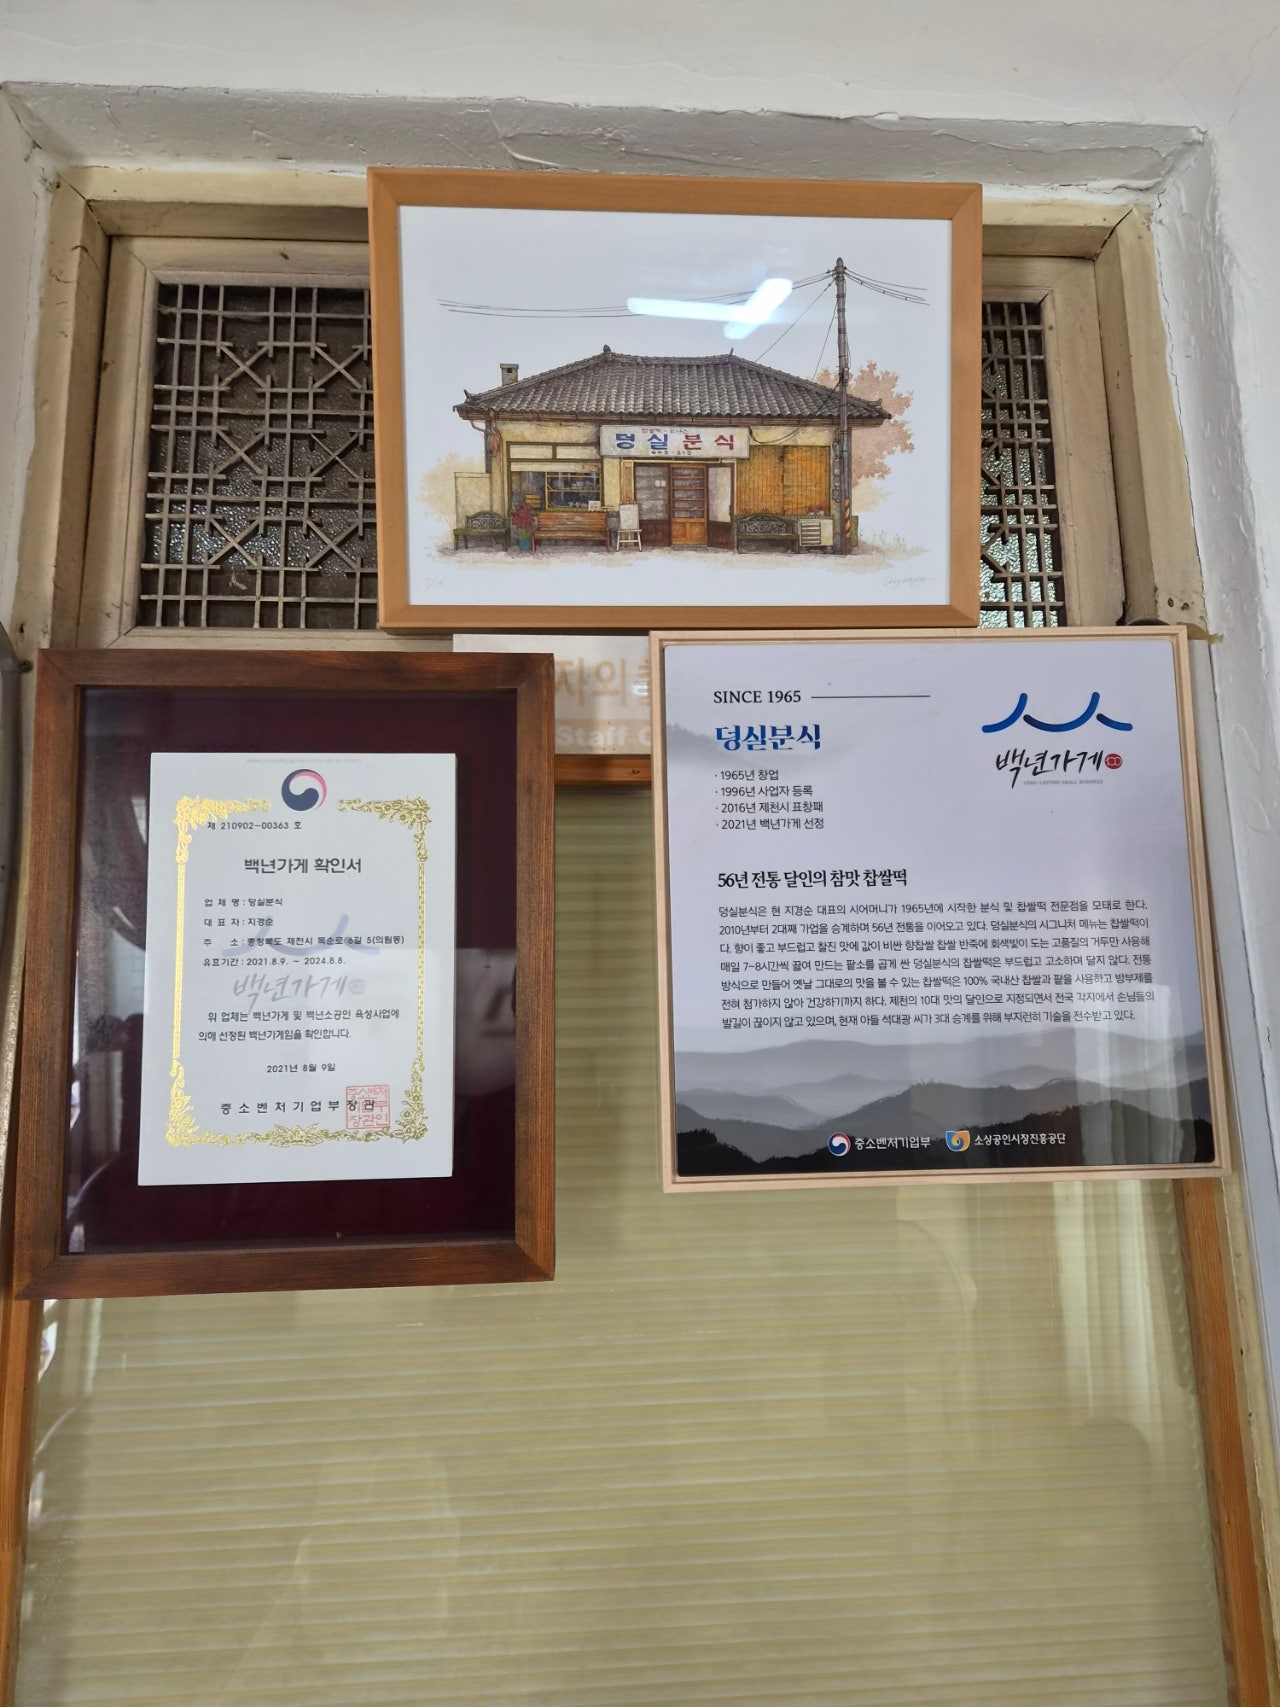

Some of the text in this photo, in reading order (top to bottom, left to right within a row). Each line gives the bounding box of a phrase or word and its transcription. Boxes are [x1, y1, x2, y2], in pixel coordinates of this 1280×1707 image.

[616, 433, 734, 450] 덩실분식
[713, 690, 801, 703] SINCE 1965
[555, 725, 628, 747] Staff
[715, 724, 821, 750] 덩실분식
[721, 769, 779, 780] 1965년 창업
[996, 748, 1103, 789] 백년가게
[721, 785, 813, 797] 1996년 사업자 등록
[721, 801, 823, 813] 2016년 제천시 표창패
[294, 821, 302, 829] 호
[721, 818, 824, 829] 2021년 백년가게 선정
[244, 858, 362, 873] 백년가게 확인서
[718, 869, 907, 888] 56년 전통 달인의 참맛 찹쌀떡
[719, 900, 1147, 918] 덩실분식은 지경순 대표의 시어머니가 1965년에 시작한 분식 찹쌀떡 전문점을 모태로 한다.
[719, 918, 1148, 935] 2010년부터 2대째 가업을 승계하며 56년 전통을 이어오고 있다. 덩실분식의 시그니처 메뉴는 찹쌀떡이
[734, 943, 753, 954] 향이
[756, 943, 775, 953] 좋고
[777, 942, 815, 953] 부드럽고
[839, 941, 859, 952] 맛에
[861, 940, 880, 952] 값이
[883, 940, 903, 951] 비싼
[937, 939, 957, 950] 찹쌀
[959, 939, 988, 950] 반죽에
[991, 938, 1028, 948] 회색빛이
[1031, 938, 1049, 948] 도는
[1052, 937, 1088, 948] 고품질의
[1121, 936, 1150, 947] 사용해
[246, 957, 289, 966] 2021.8.9.
[304, 957, 346, 965] 2024.8.8.
[721, 962, 740, 972] 매일
[743, 961, 789, 972] 7~8시간씩
[815, 960, 843, 971] 만드는
[846, 959, 875, 970] 팥소를
[878, 959, 896, 970] 곱게
[914, 958, 959, 969] 덩실분식의
[963, 957, 1001, 968] 찹쌀떡은
[1005, 956, 1042, 967] 부드럽고
[1045, 956, 1083, 966] 고소하며
[1086, 955, 1105, 966] 달지
[1108, 955, 1130, 966] 않다.
[1133, 954, 1151, 965] 전통
[721, 973, 1153, 991] 방식으로 만들어 옛날 그대로의 맛을 있는 찹쌀떡은 100% 국내산 찹쌀과 팥을 사용하고 방부제를
[233, 973, 348, 1014] 백년가게
[722, 991, 1154, 1010] 전혀 첨가하지 않아 건강하기까지 하다. 제천의 10대 맛의 달인으로 지정되면서 전국 각지에서 손님들의
[208, 1009, 400, 1022] 위 업체는 백년가게 및 백년소공인 육성사업에
[723, 1010, 1136, 1029] 발길이 끊이지 않고 있으며, 현재 아들 석대광 씨가 3대 승계를 위해 부지런히 기술을 전수받고 있다.
[199, 1029, 351, 1041] 의해 선정된 백년가게임을 확인합니다.
[266, 1063, 336, 1073] 2021년 8월 9일
[854, 1136, 931, 1150] 중소벤처기업부
[974, 1133, 1066, 1146] 소상공인시장진흥공단
